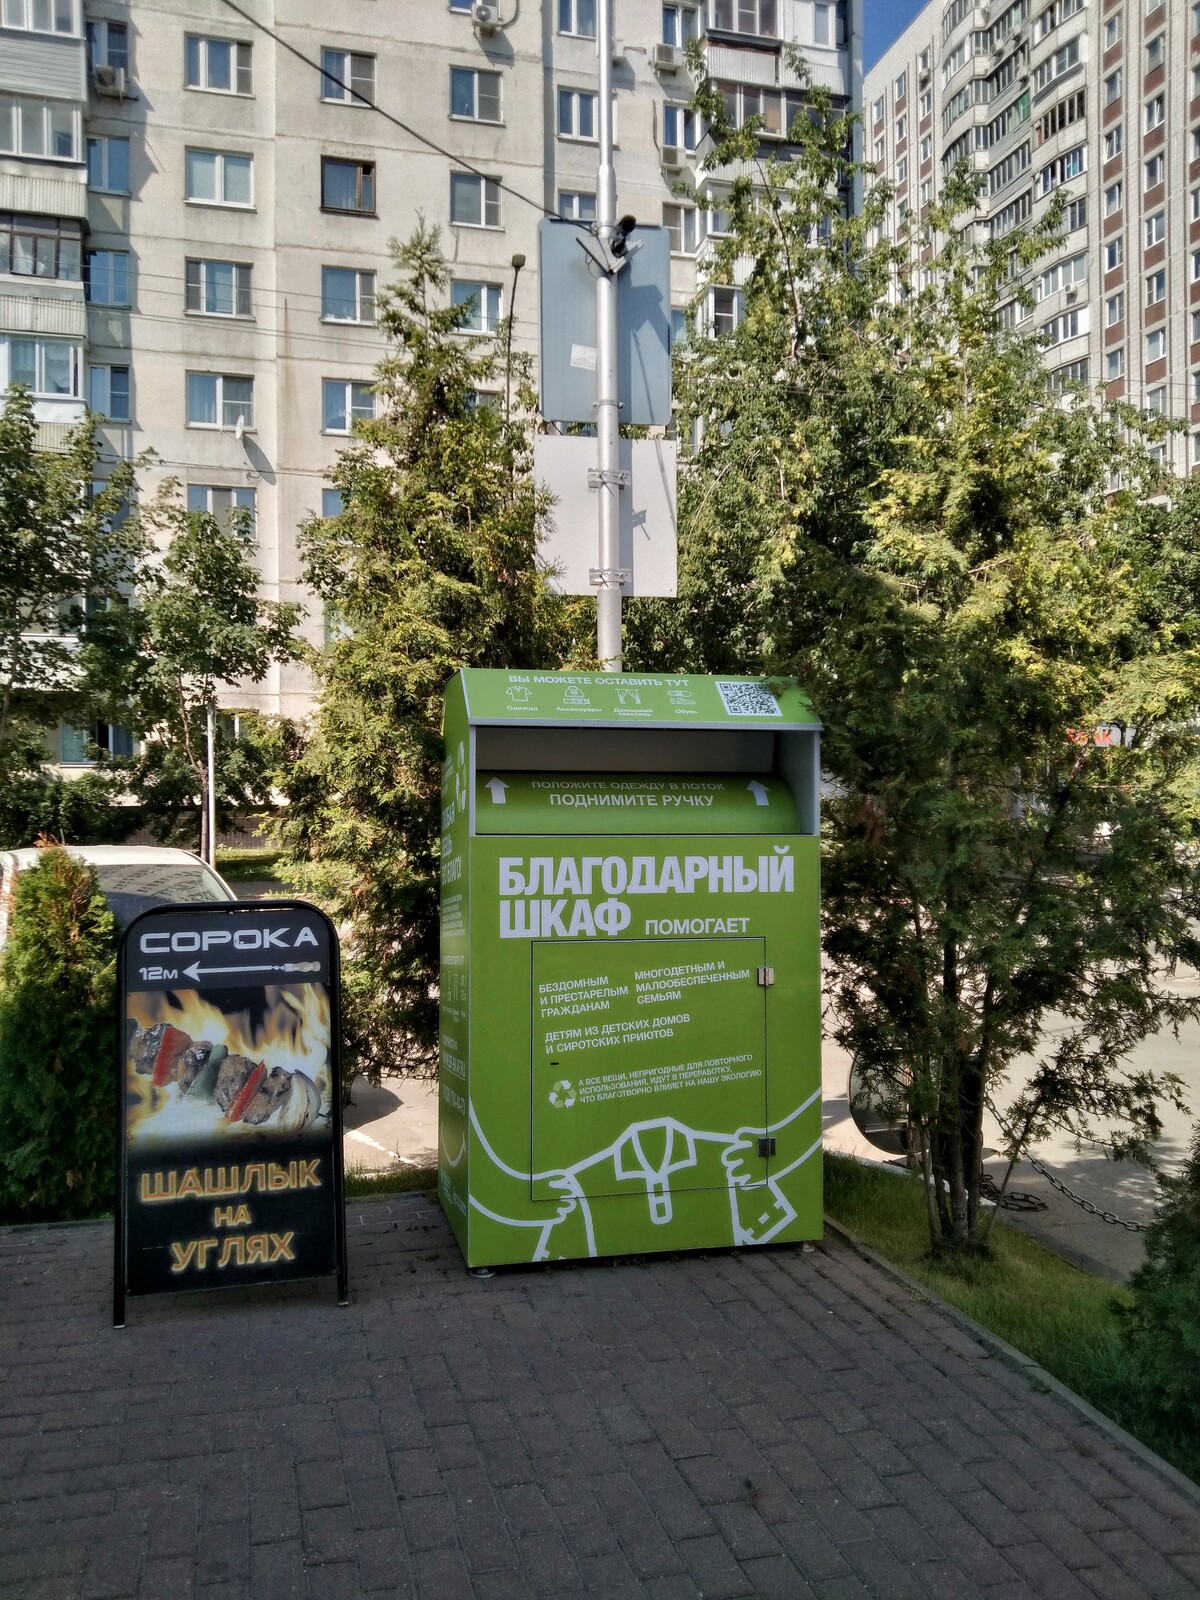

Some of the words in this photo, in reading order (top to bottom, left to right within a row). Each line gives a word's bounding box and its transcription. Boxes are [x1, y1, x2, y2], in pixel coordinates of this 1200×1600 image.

[509, 675, 530, 683] ВЫ
[533, 676, 592, 685] МОЖЕТЕ
[595, 677, 662, 686] ОСТАВИТЬ
[665, 679, 689, 687] ТУТ
[531, 781, 608, 789] ПОЛОЖИТЕ
[610, 782, 665, 791] ОДЕЖДУ
[682, 783, 725, 791] ЛОТОК
[549, 793, 658, 808] ПОДНИМИТЕ
[662, 795, 714, 807] РУЧКУ
[499, 845, 795, 896] БЛАГОДАРНЫЙ
[499, 897, 632, 939] ШКАФ
[645, 917, 750, 936] ПОМОГАЕТ
[139, 926, 319, 954] СОРОКА
[634, 962, 715, 981] МНОГОДЕТНЫМ
[717, 961, 725, 970] И
[635, 969, 750, 993] МАЛООБЕСПЕЧЕННЫМ
[538, 976, 609, 993] БЕЗДОМНЫМ
[540, 997, 548, 1006] И
[550, 986, 629, 1004] ПРЕСТАРЕЛЫМ
[541, 1001, 610, 1018] ГРАЖДАНАМ
[637, 991, 682, 1005] СЕМЬЯМ
[545, 1028, 582, 1043] ДЕТЯМ
[584, 1026, 599, 1036] ИЗ
[601, 1019, 650, 1035] ДЕТСКИХ
[652, 1014, 691, 1027] ДОМОВ
[545, 1045, 554, 1054] И
[556, 1036, 620, 1053] СИРОТСКИХ
[623, 1028, 674, 1043] ПРИЮТОВ
[578, 1079, 585, 1087] А
[586, 1076, 601, 1085] ВСЕ
[603, 1073, 628, 1083] ВЕЩИ,
[629, 1064, 685, 1079] НЕПРИГОДНЫЕ
[687, 1062, 703, 1071] ДЛЯ
[704, 1054, 753, 1067] ПОВТОРНОГО
[579, 1078, 648, 1095] ИСПОЛЬЗОВАНИЯ,
[650, 1075, 670, 1085] ИДУТ
[679, 1066, 732, 1080] ПЕРЕРАБОТКУ,
[580, 1095, 595, 1103] ЧТО
[597, 1086, 652, 1101] БЛАГОТВОРНО
[654, 1083, 683, 1092] ВЛИЯЕТ
[698, 1076, 719, 1086] НАШУ
[721, 1069, 762, 1082] ЭКОЛОГИЮ
[140, 1158, 322, 1203] ШАШЛЫК
[213, 1204, 252, 1227] НА
[171, 1231, 295, 1272] УГЛЯХ
